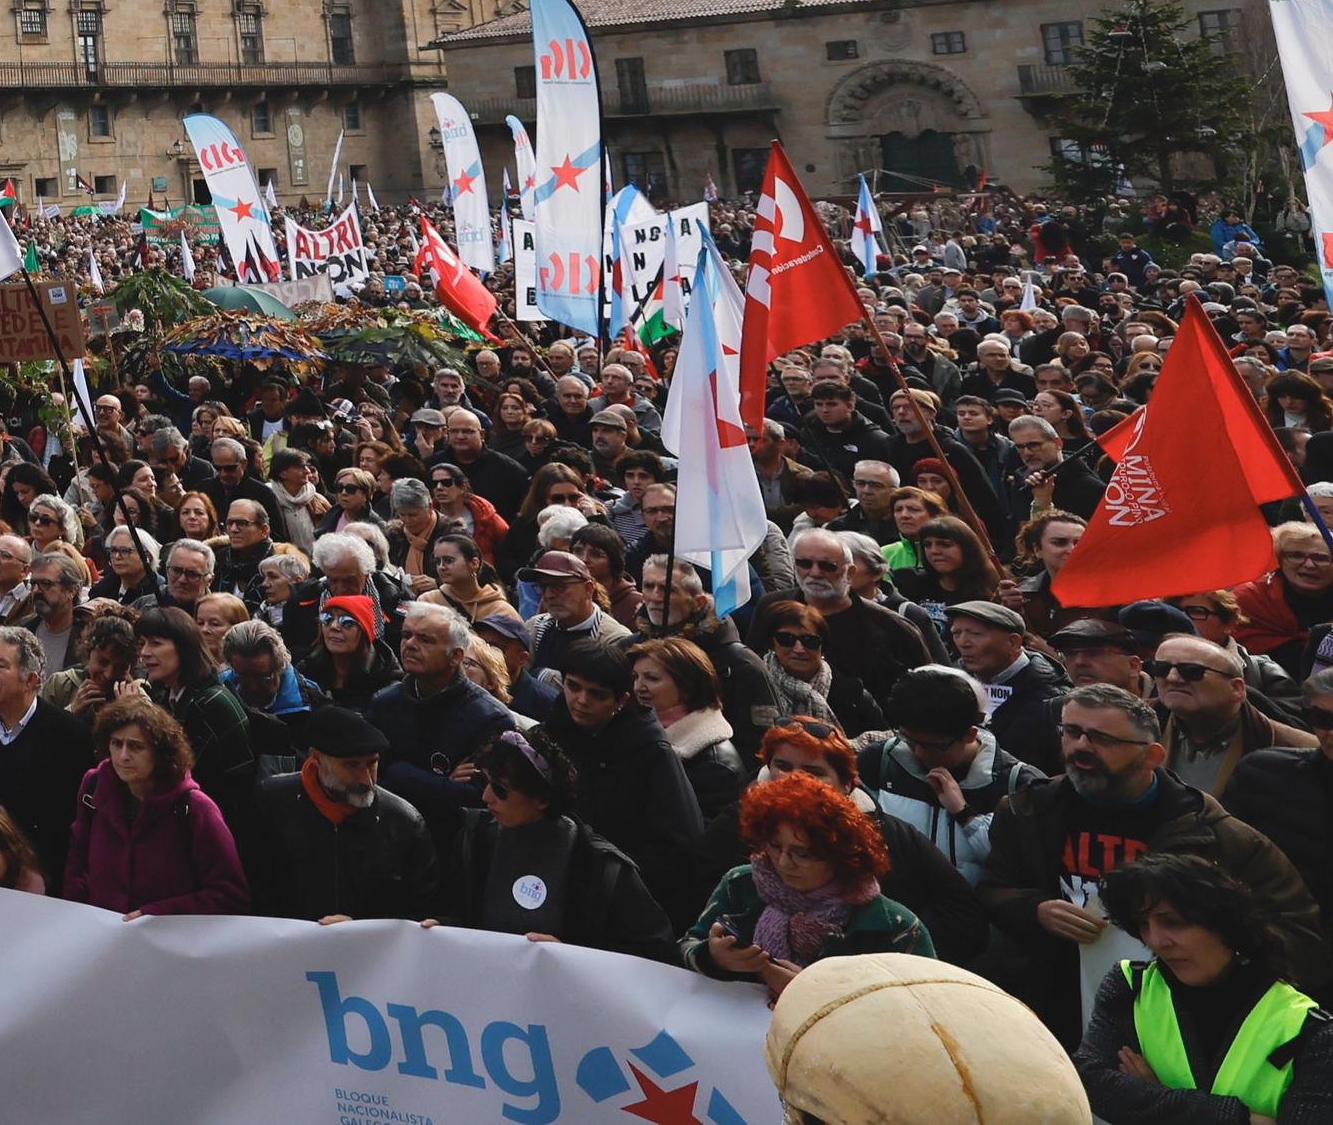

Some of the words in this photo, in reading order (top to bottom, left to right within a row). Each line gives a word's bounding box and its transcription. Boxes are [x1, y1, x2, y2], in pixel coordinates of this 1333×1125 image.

[295, 214, 360, 260] ALTRI
[295, 248, 364, 283] NON
[1125, 455, 1166, 522] MINA
[990, 687, 1011, 700] NON
[305, 971, 562, 1125] bng
[335, 1088, 389, 1107] BLOQUE
[337, 1103, 434, 1125] NACIONALISTA
